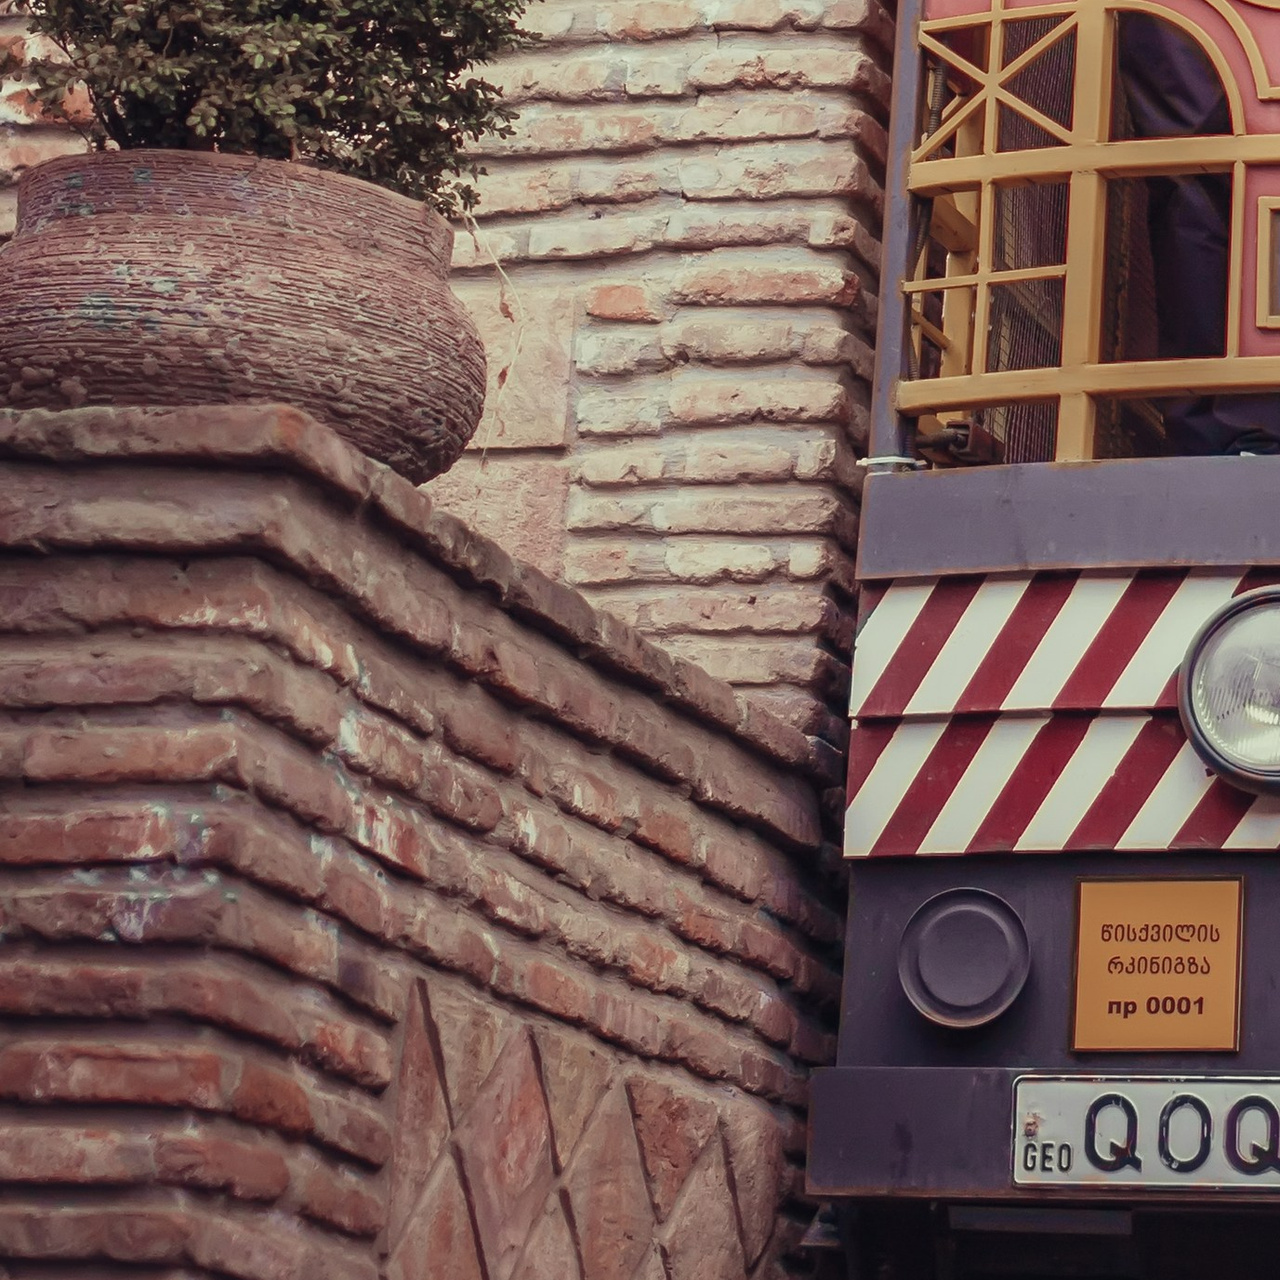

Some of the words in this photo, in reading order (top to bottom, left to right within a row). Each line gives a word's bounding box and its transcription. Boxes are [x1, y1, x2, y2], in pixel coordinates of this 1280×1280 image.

[1100, 923, 1220, 942] წისქვილის
[1107, 956, 1211, 975] რკინიგზა
[1146, 996, 1205, 1015] 0001
[1022, 1141, 1074, 1174] GEO
